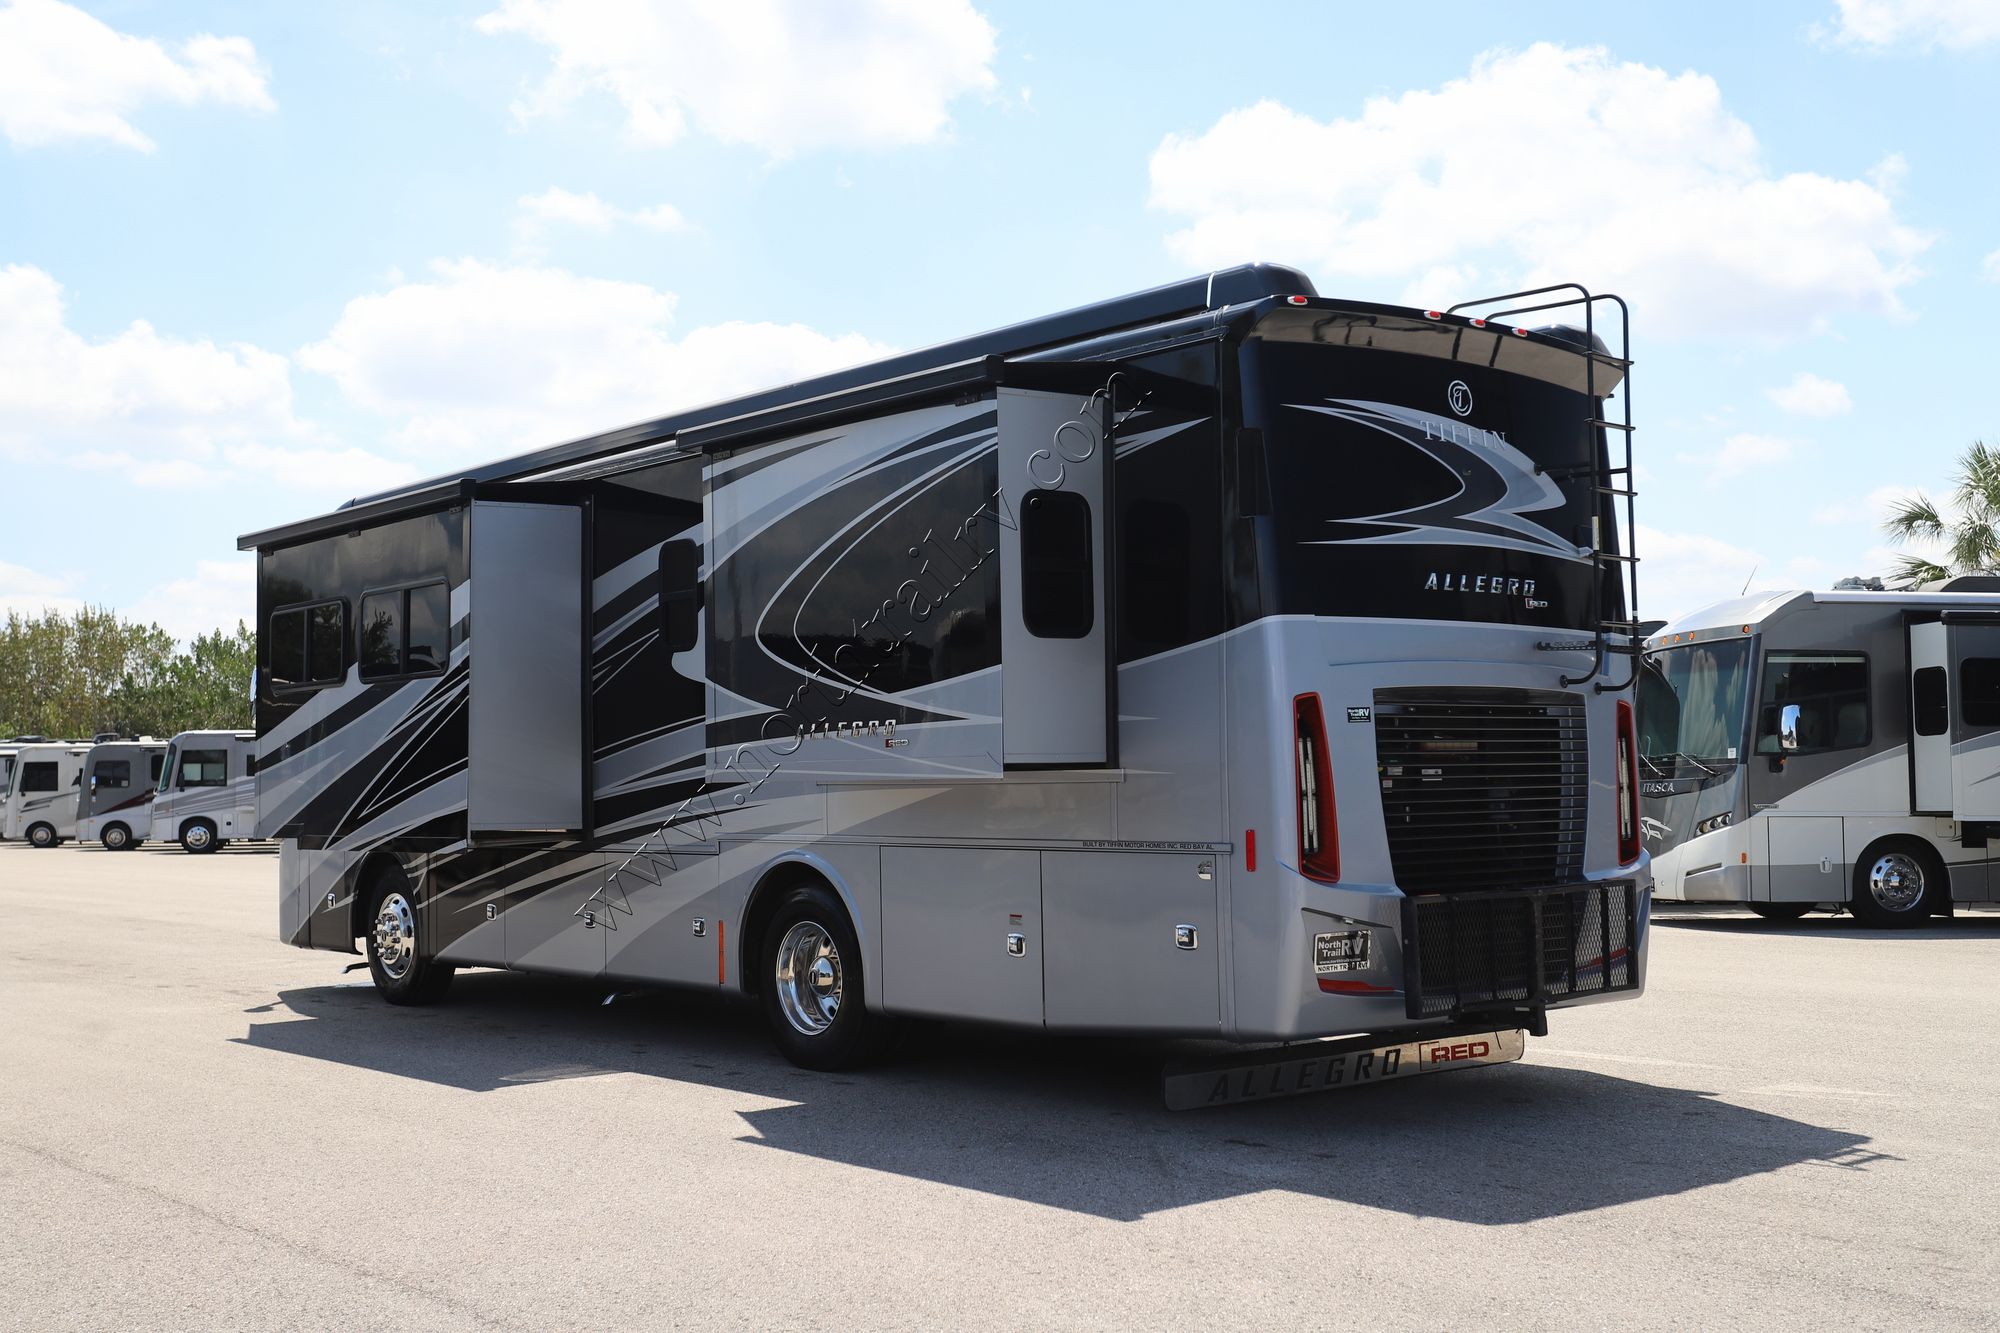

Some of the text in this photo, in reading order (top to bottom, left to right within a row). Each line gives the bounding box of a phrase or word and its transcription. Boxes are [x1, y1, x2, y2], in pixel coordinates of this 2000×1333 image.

[1419, 420, 1506, 450] TIFFIN
[1424, 572, 1535, 597] ALLEGRO
[794, 719, 897, 740] ALLEGRO
[1642, 782, 1675, 793] ITASCA
[1318, 938, 1363, 955] North RV
[1322, 949, 1341, 957] Trail
[1318, 963, 1338, 972] NORTH
[1208, 1040, 1490, 1102] ALLEGRO RED
